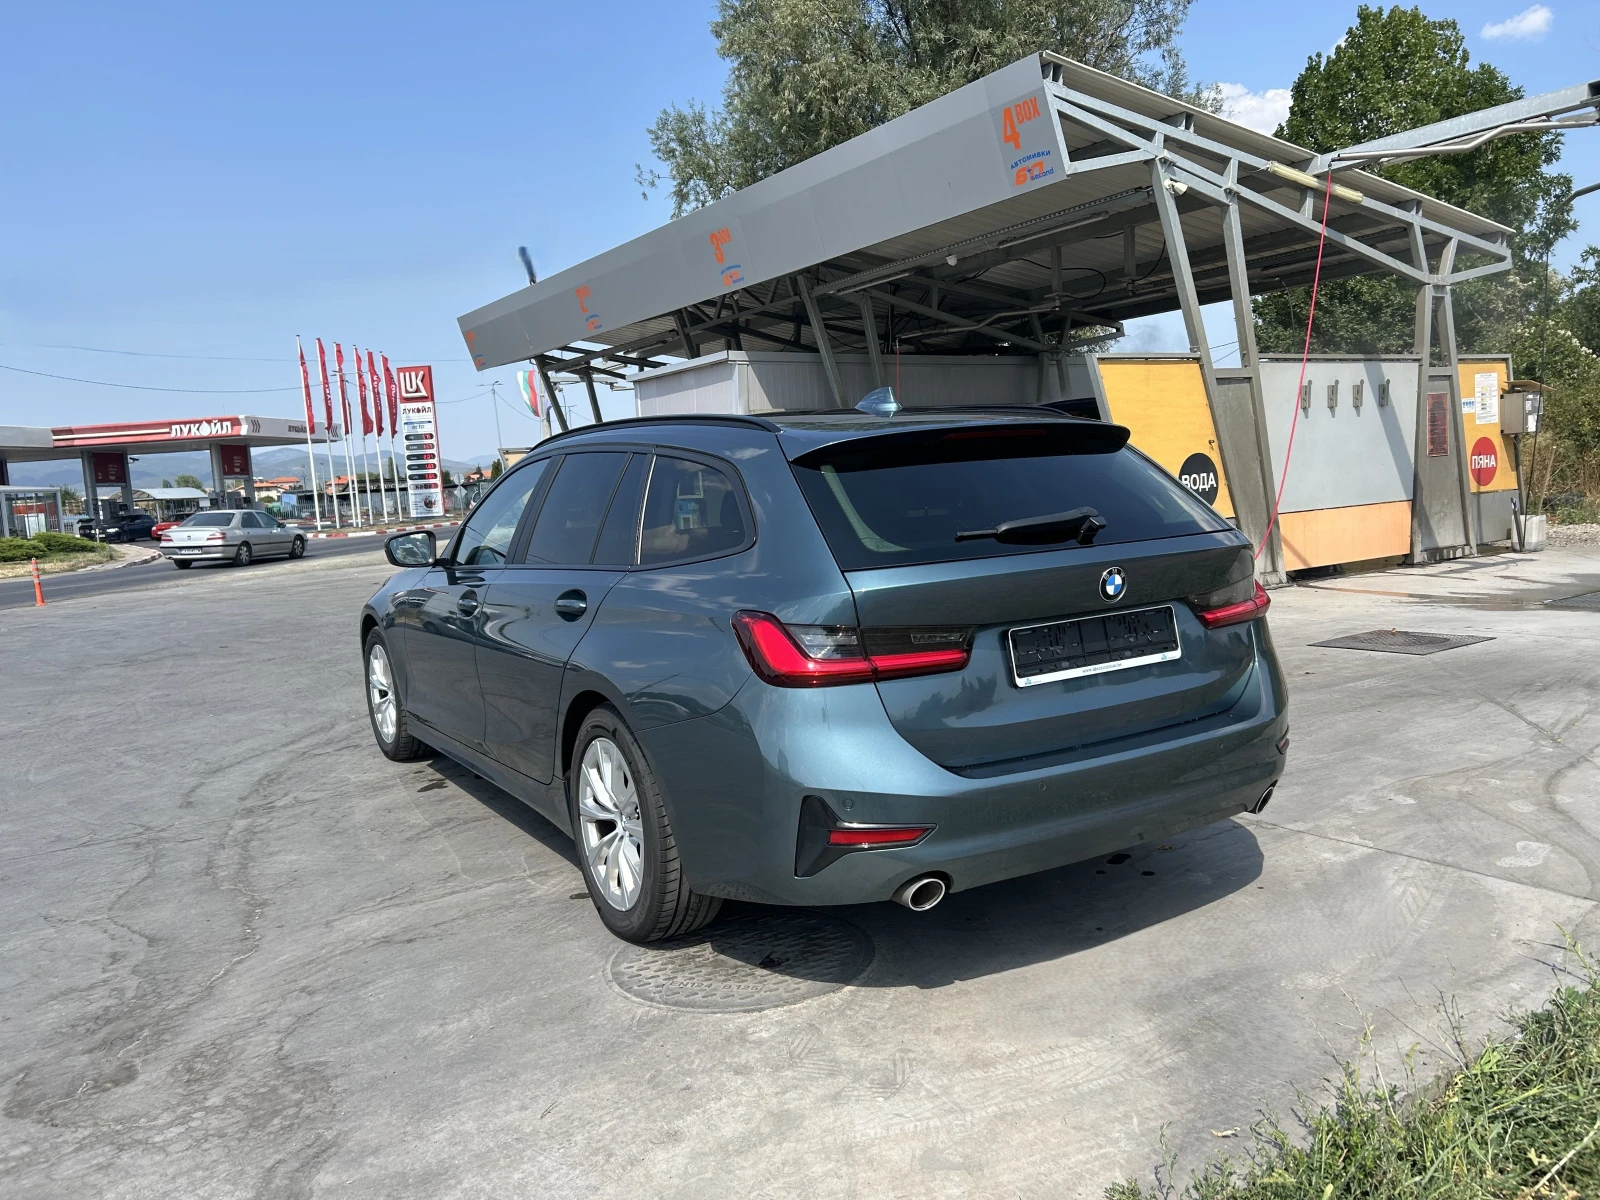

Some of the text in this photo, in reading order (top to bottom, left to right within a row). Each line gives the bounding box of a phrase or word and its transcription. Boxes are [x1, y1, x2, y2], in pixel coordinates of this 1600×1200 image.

[1003, 96, 1041, 150] 4 BOX
[1011, 150, 1051, 170] АВТОМИВКИ
[1031, 167, 1054, 181] second
[402, 405, 432, 415] ЛУКОЙЛ
[171, 420, 232, 438] ЛУКОЙЛ
[1471, 454, 1497, 469] ПЯНА
[1181, 472, 1217, 492] ВОДА
